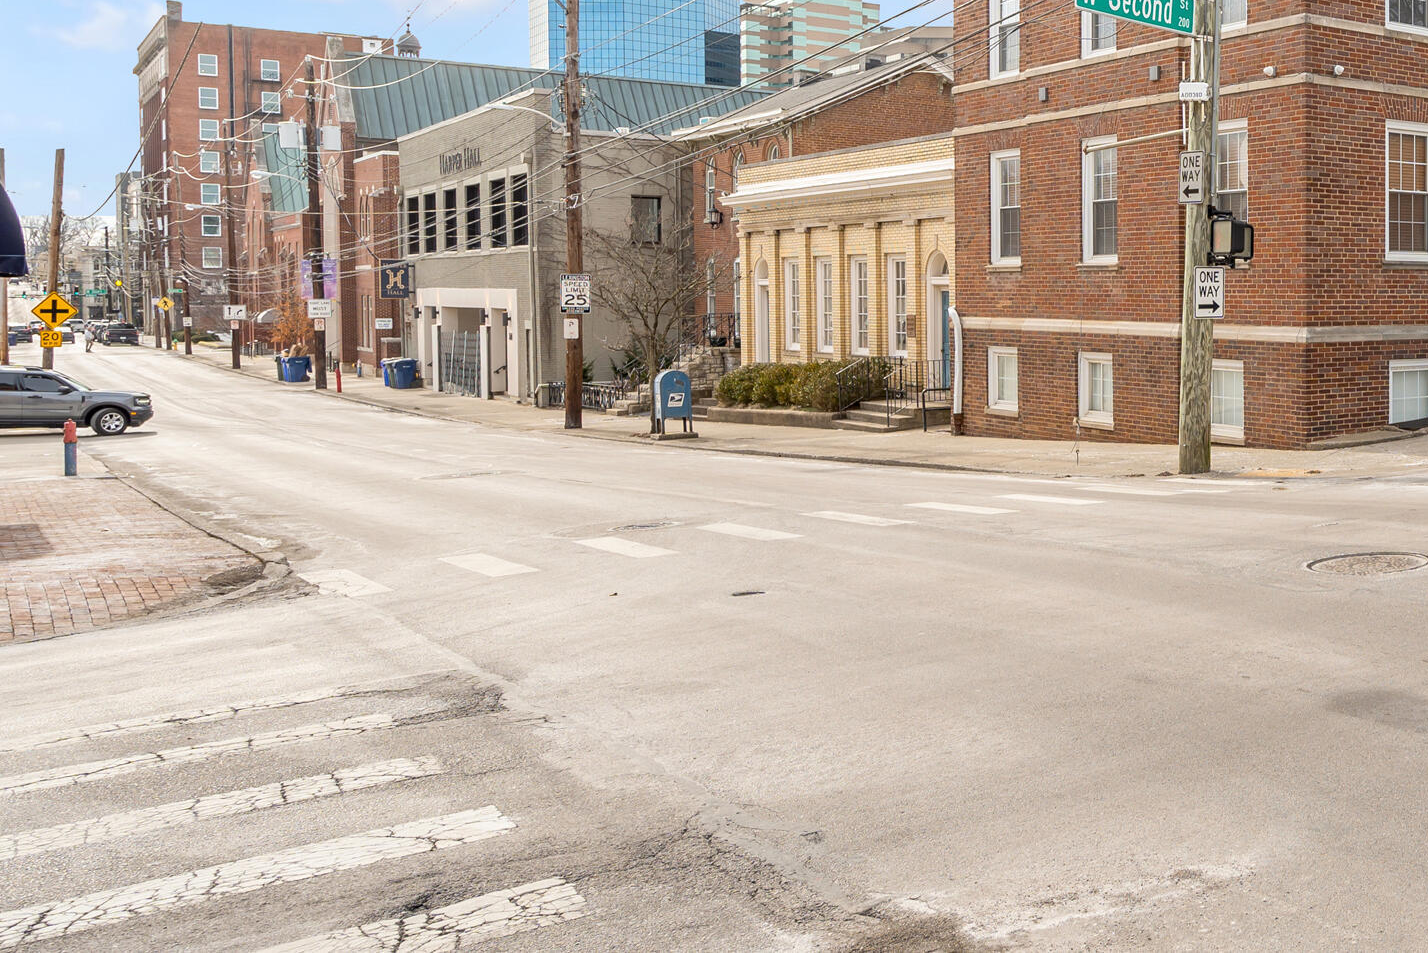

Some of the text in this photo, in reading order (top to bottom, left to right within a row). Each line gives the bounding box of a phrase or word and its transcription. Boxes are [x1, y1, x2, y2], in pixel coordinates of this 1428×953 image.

[1178, 16, 1190, 28] 200
[1182, 155, 1200, 168] ONE
[1182, 170, 1200, 182] WAY
[1199, 271, 1220, 283] ONE
[1199, 286, 1220, 297] WAY
[565, 294, 587, 305] 25
[42, 332, 59, 341] 20
